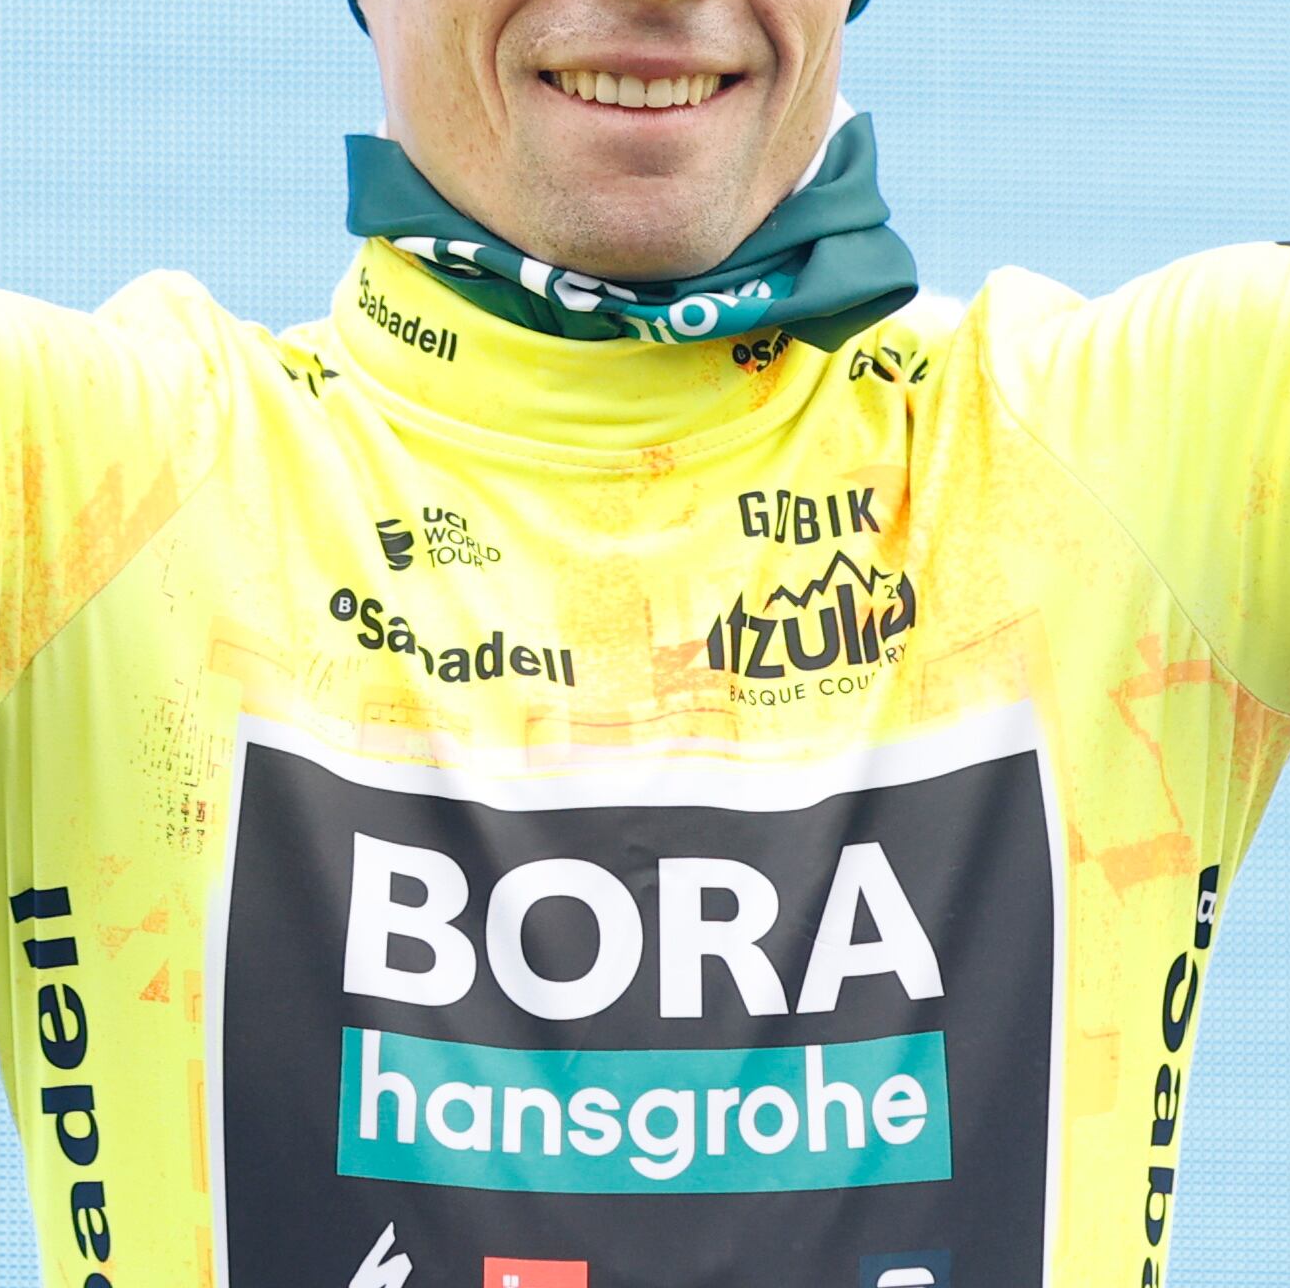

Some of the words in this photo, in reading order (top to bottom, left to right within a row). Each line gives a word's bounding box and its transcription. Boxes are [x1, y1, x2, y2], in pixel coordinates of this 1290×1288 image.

[423, 507, 467, 531] UCI
[424, 527, 501, 562] WORLD
[427, 546, 484, 571] TOUR
[730, 684, 806, 706] BASQUE
[819, 643, 907, 696] COURY
[343, 831, 944, 1020] BORA
[359, 1028, 927, 1180] hansgrohe
